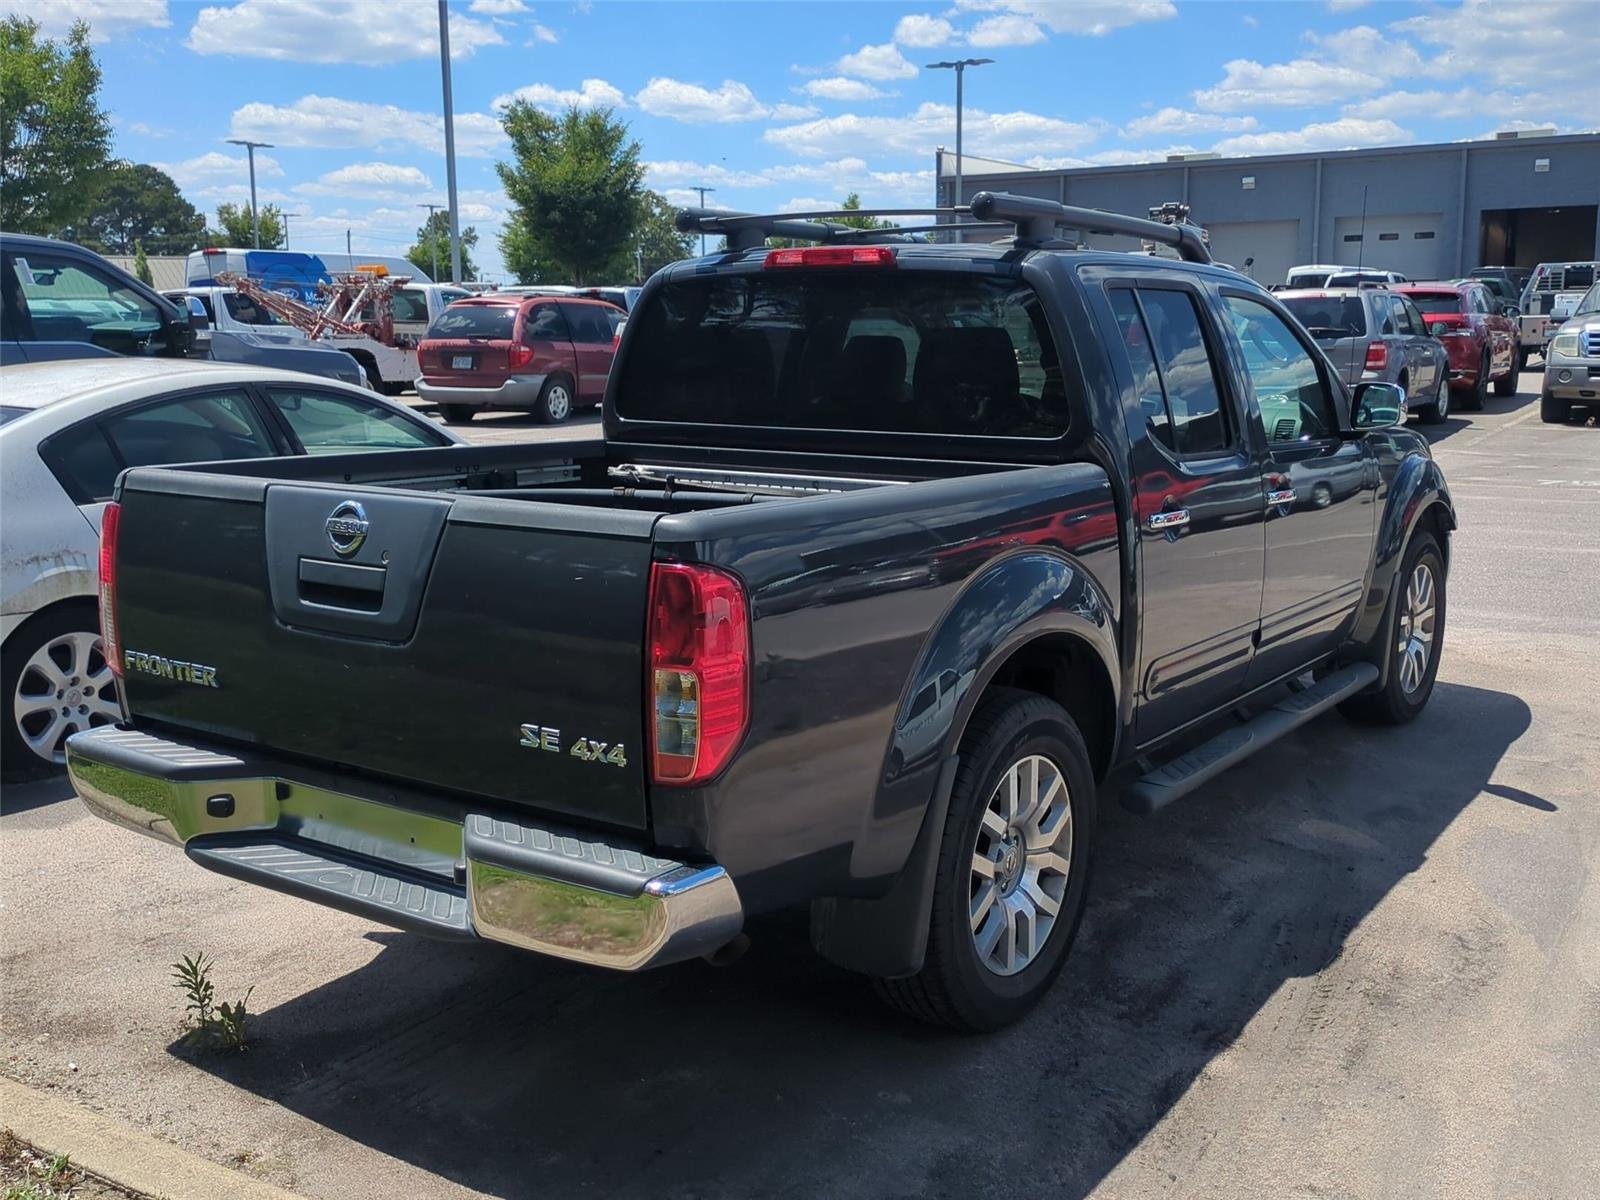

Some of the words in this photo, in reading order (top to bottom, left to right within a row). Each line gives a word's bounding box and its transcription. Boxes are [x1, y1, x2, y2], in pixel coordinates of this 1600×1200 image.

[327, 518, 368, 535] NISSAN
[124, 649, 219, 688] FRONTIER
[520, 723, 560, 753] SE
